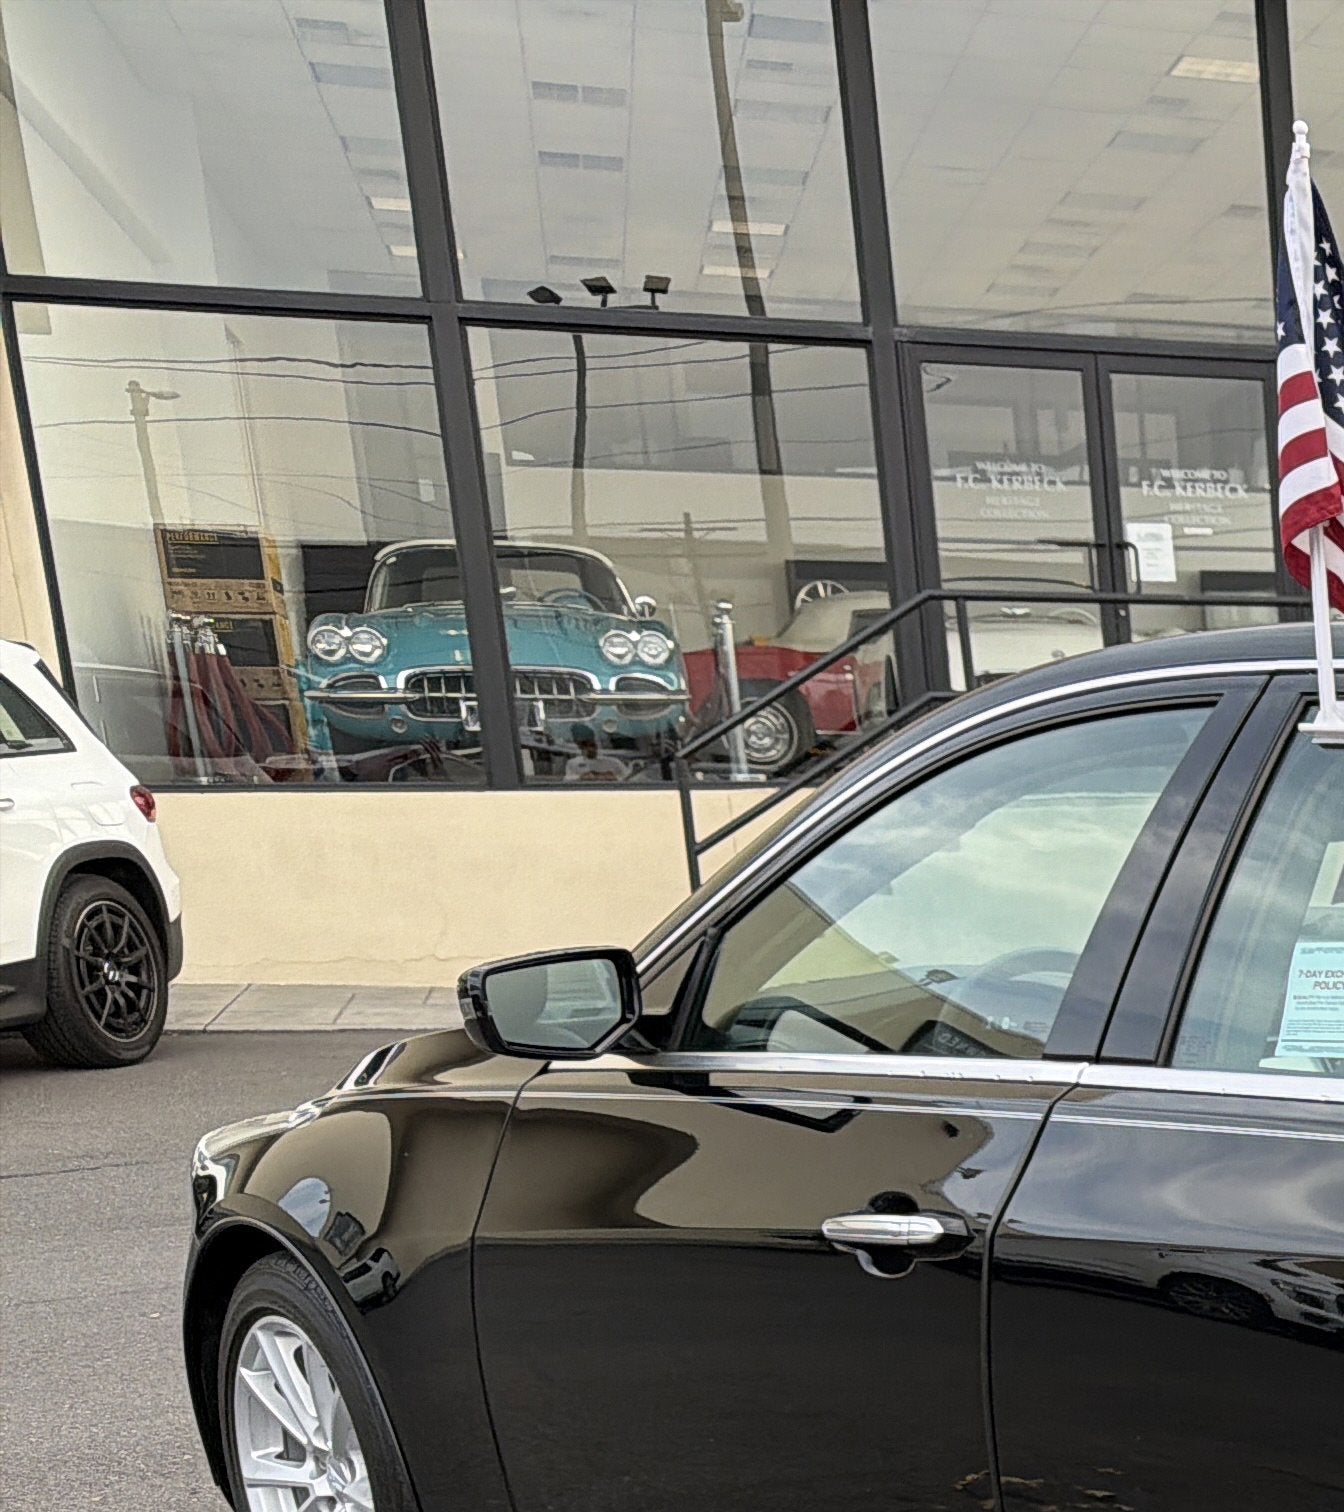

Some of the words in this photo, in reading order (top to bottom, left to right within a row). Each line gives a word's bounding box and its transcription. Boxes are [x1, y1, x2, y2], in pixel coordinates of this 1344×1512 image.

[1160, 468, 1210, 480] WELCOME
[989, 474, 1067, 492] KERBECK
[1174, 481, 1249, 499] KERBECK
[1298, 969, 1324, 979] 7-DAY
